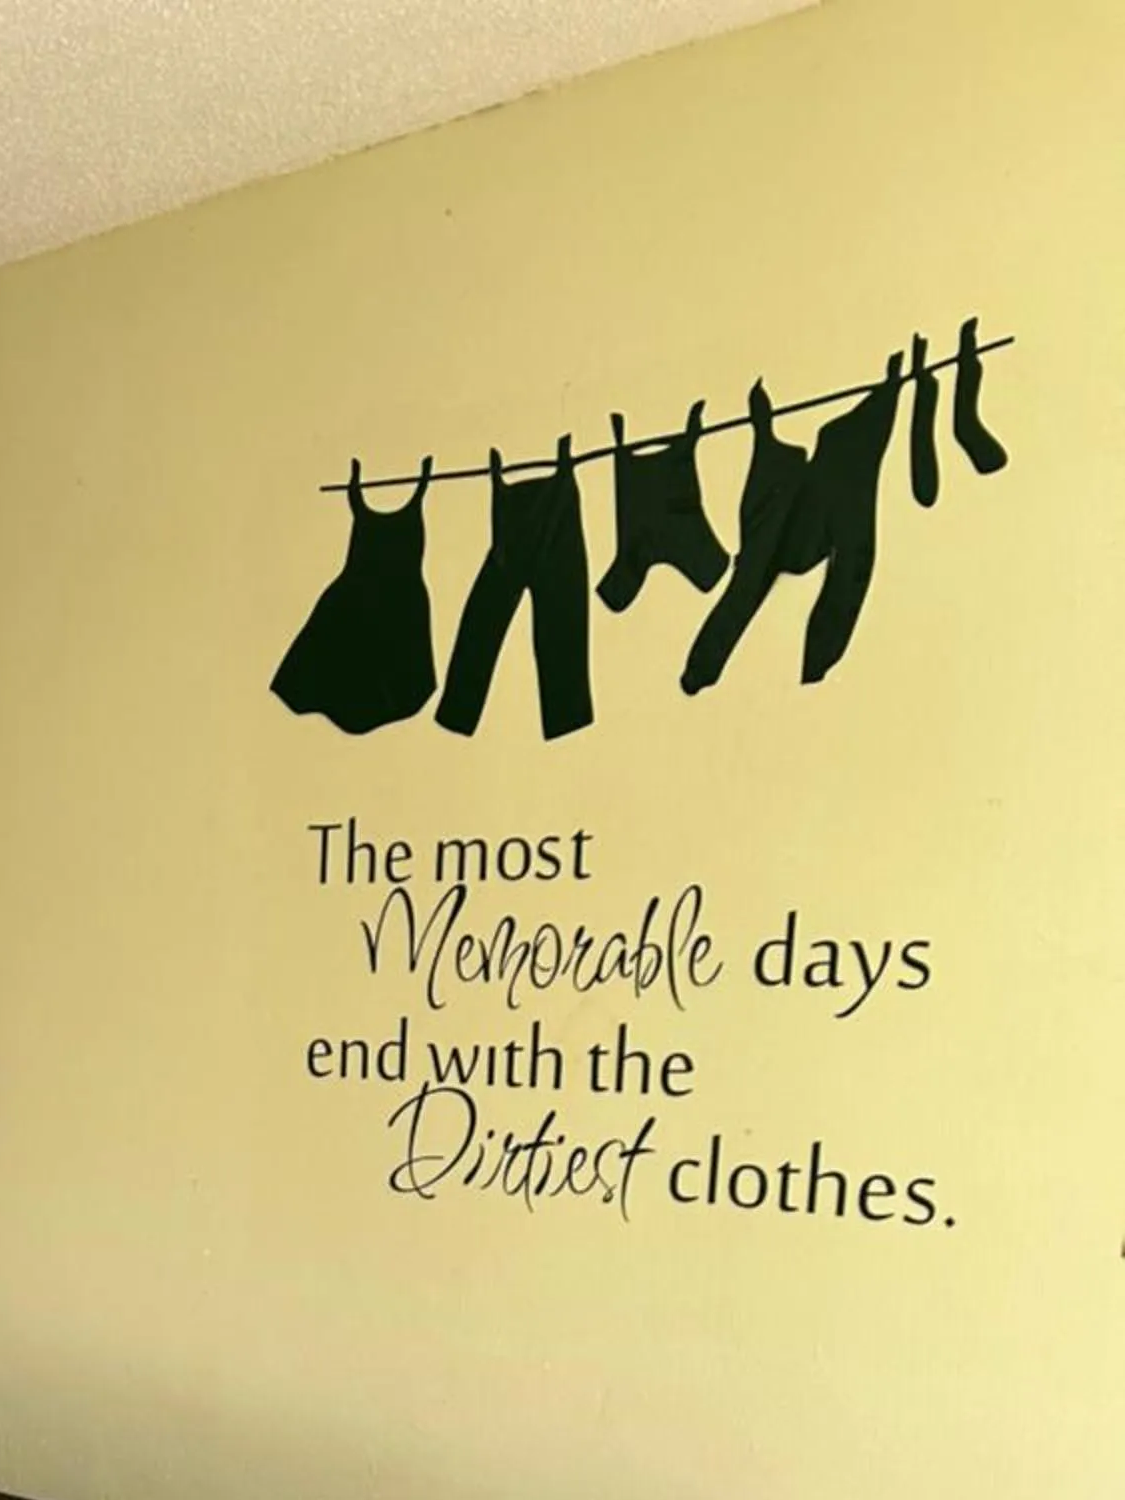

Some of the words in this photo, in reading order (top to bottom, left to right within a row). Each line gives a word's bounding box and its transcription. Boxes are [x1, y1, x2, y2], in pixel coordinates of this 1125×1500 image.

[306, 815, 414, 886] The
[434, 828, 594, 883] most
[359, 883, 725, 1012] Memorable
[753, 909, 932, 1020] days
[306, 1015, 409, 1083] end
[426, 1019, 564, 1091] with
[586, 1022, 695, 1098] the
[387, 1079, 657, 1223] Dirtiest
[668, 1133, 956, 1229] clothes.
